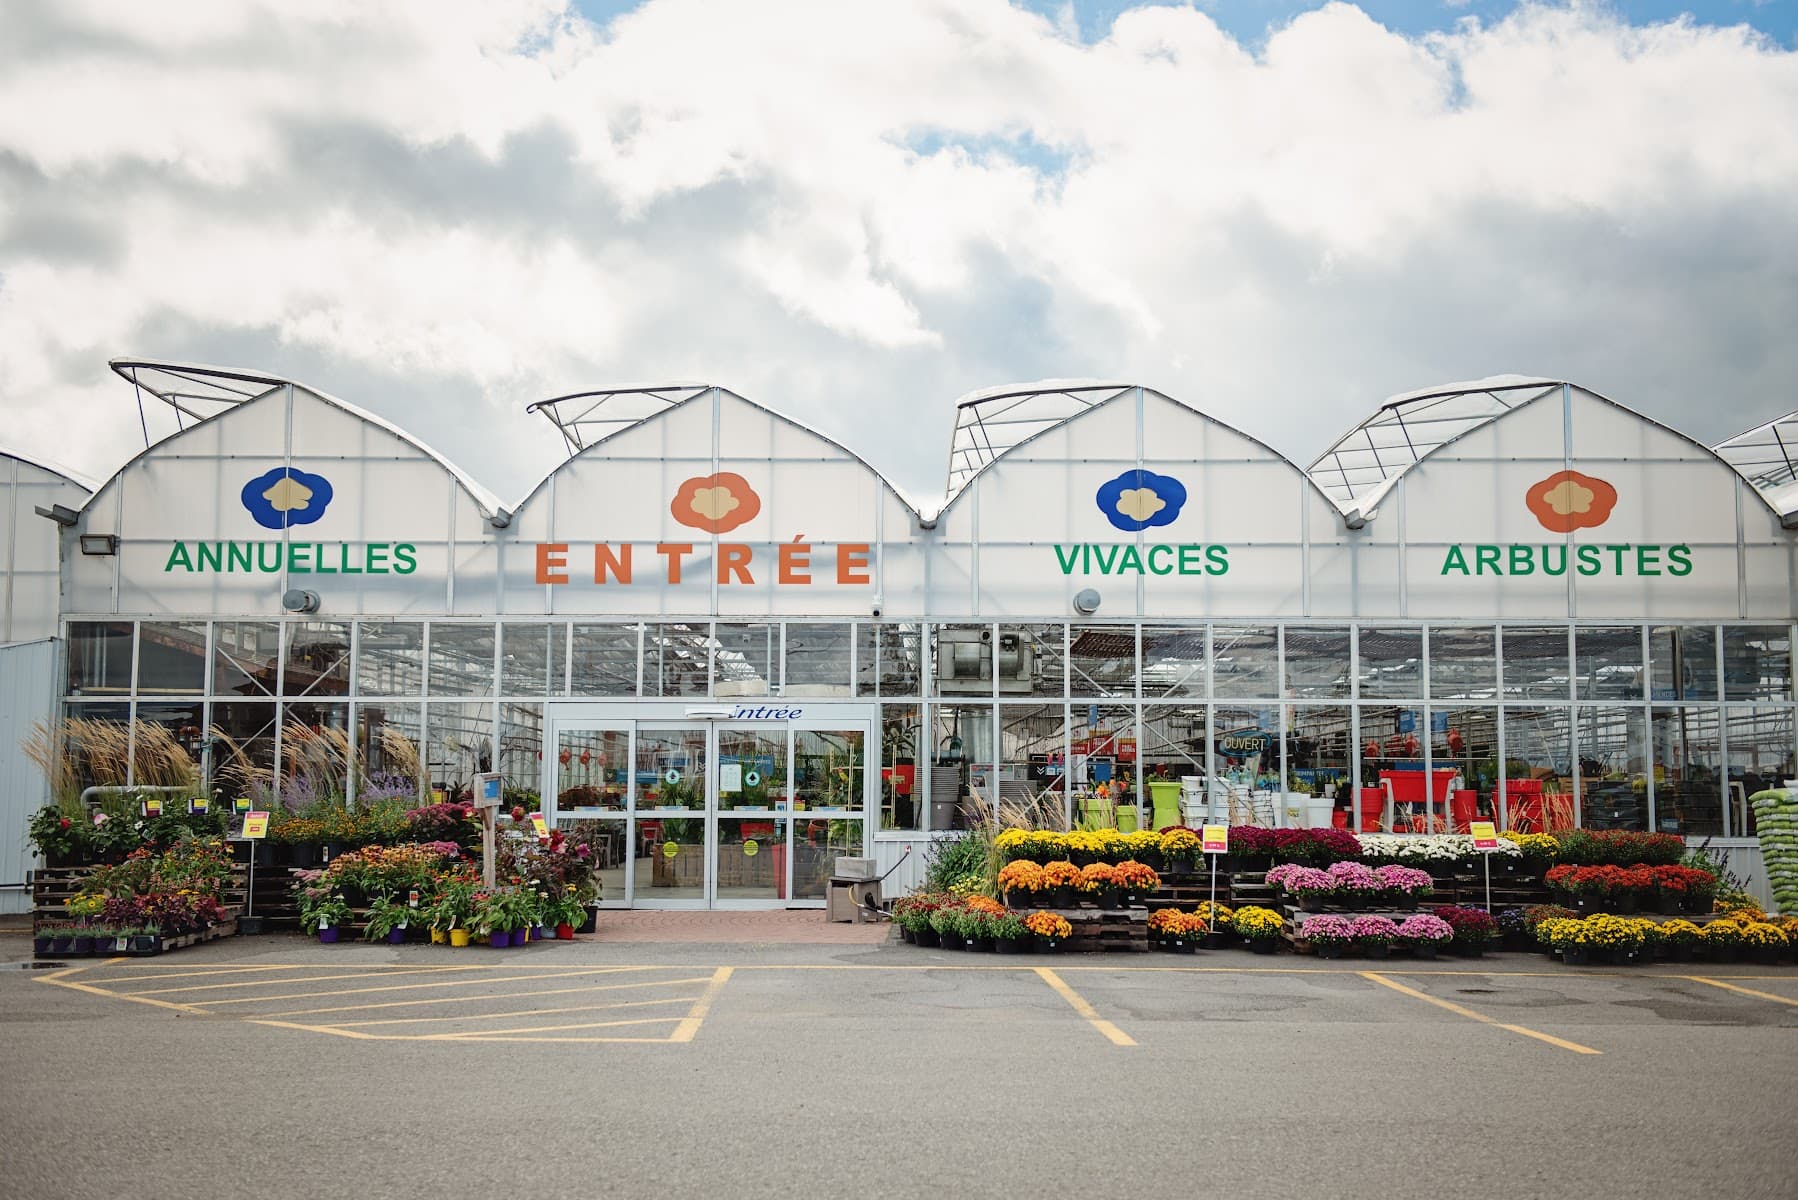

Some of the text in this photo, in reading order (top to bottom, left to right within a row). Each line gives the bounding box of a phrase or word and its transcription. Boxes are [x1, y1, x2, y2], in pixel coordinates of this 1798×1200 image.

[166, 541, 416, 575] ANNUELLES
[536, 534, 870, 584] ENTRÉE
[1054, 544, 1229, 576] VIVACES
[1441, 544, 1692, 576] ARBUSTES
[729, 705, 803, 720] ntrée
[1224, 736, 1266, 751] OUVERT
